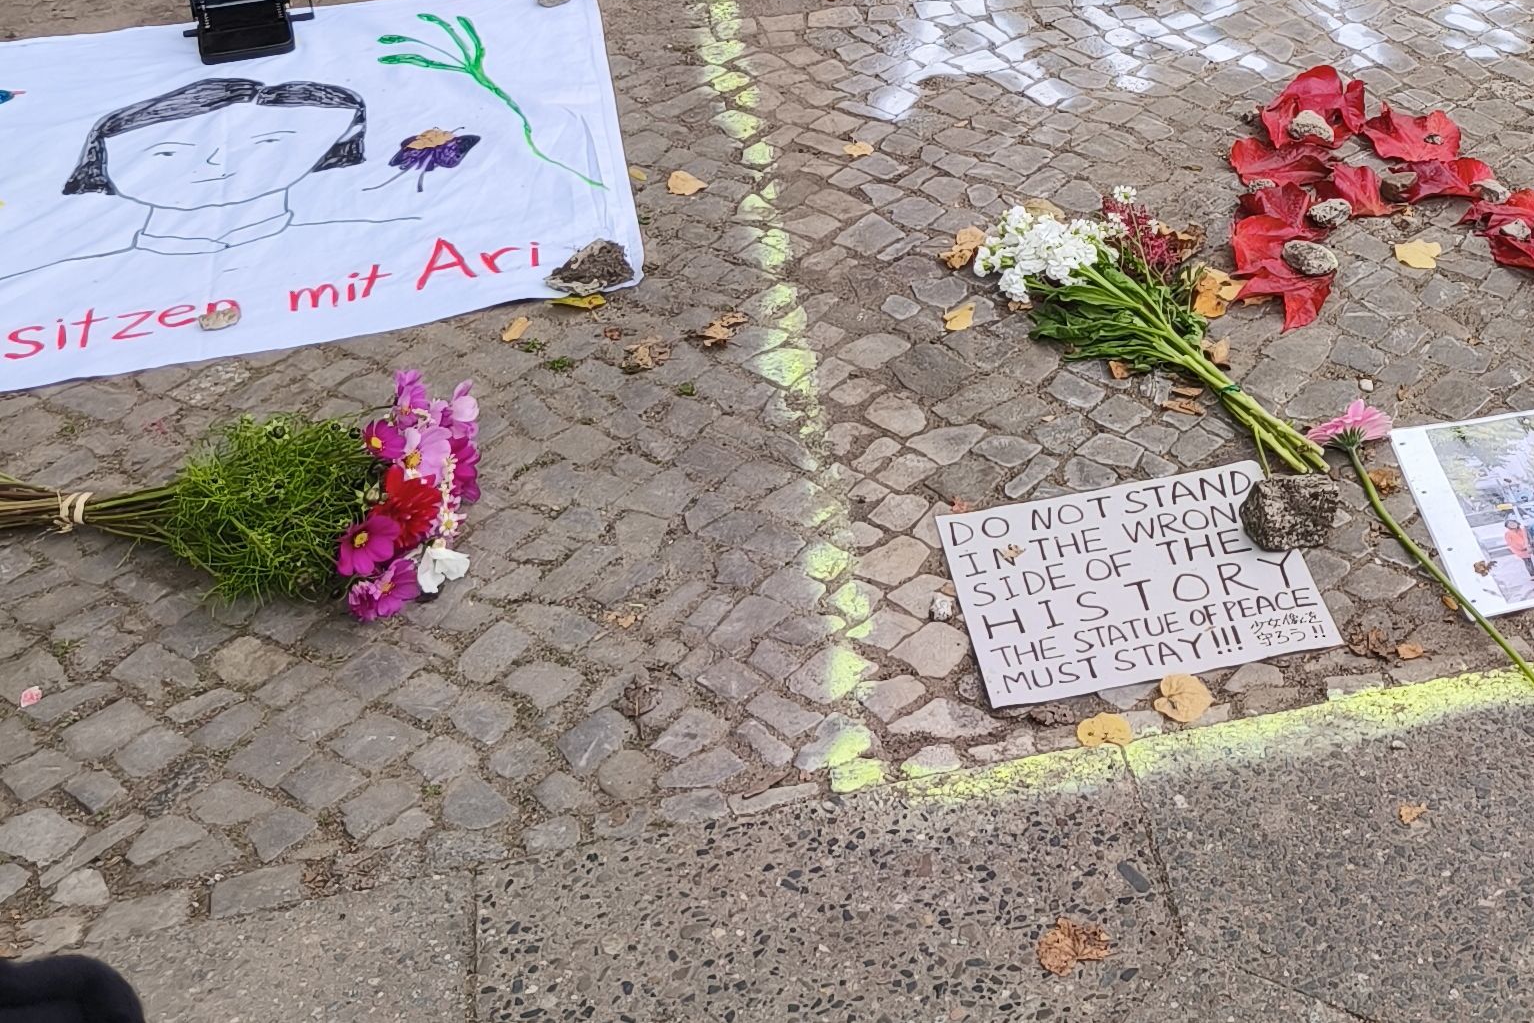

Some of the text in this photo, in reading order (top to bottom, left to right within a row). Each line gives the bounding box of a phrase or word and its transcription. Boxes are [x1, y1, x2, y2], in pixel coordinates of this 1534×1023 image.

[287, 263, 394, 313] mit
[415, 236, 541, 291] Ari
[949, 470, 1251, 546] DO NOT STAND
[959, 502, 1240, 578] IN THE WRON
[973, 528, 1253, 607] SIDE OF THE
[981, 549, 1303, 641] HISTORY
[990, 587, 1318, 668] THE STATUE OF PEACE
[1002, 625, 1242, 694] MUST STAY!!!
